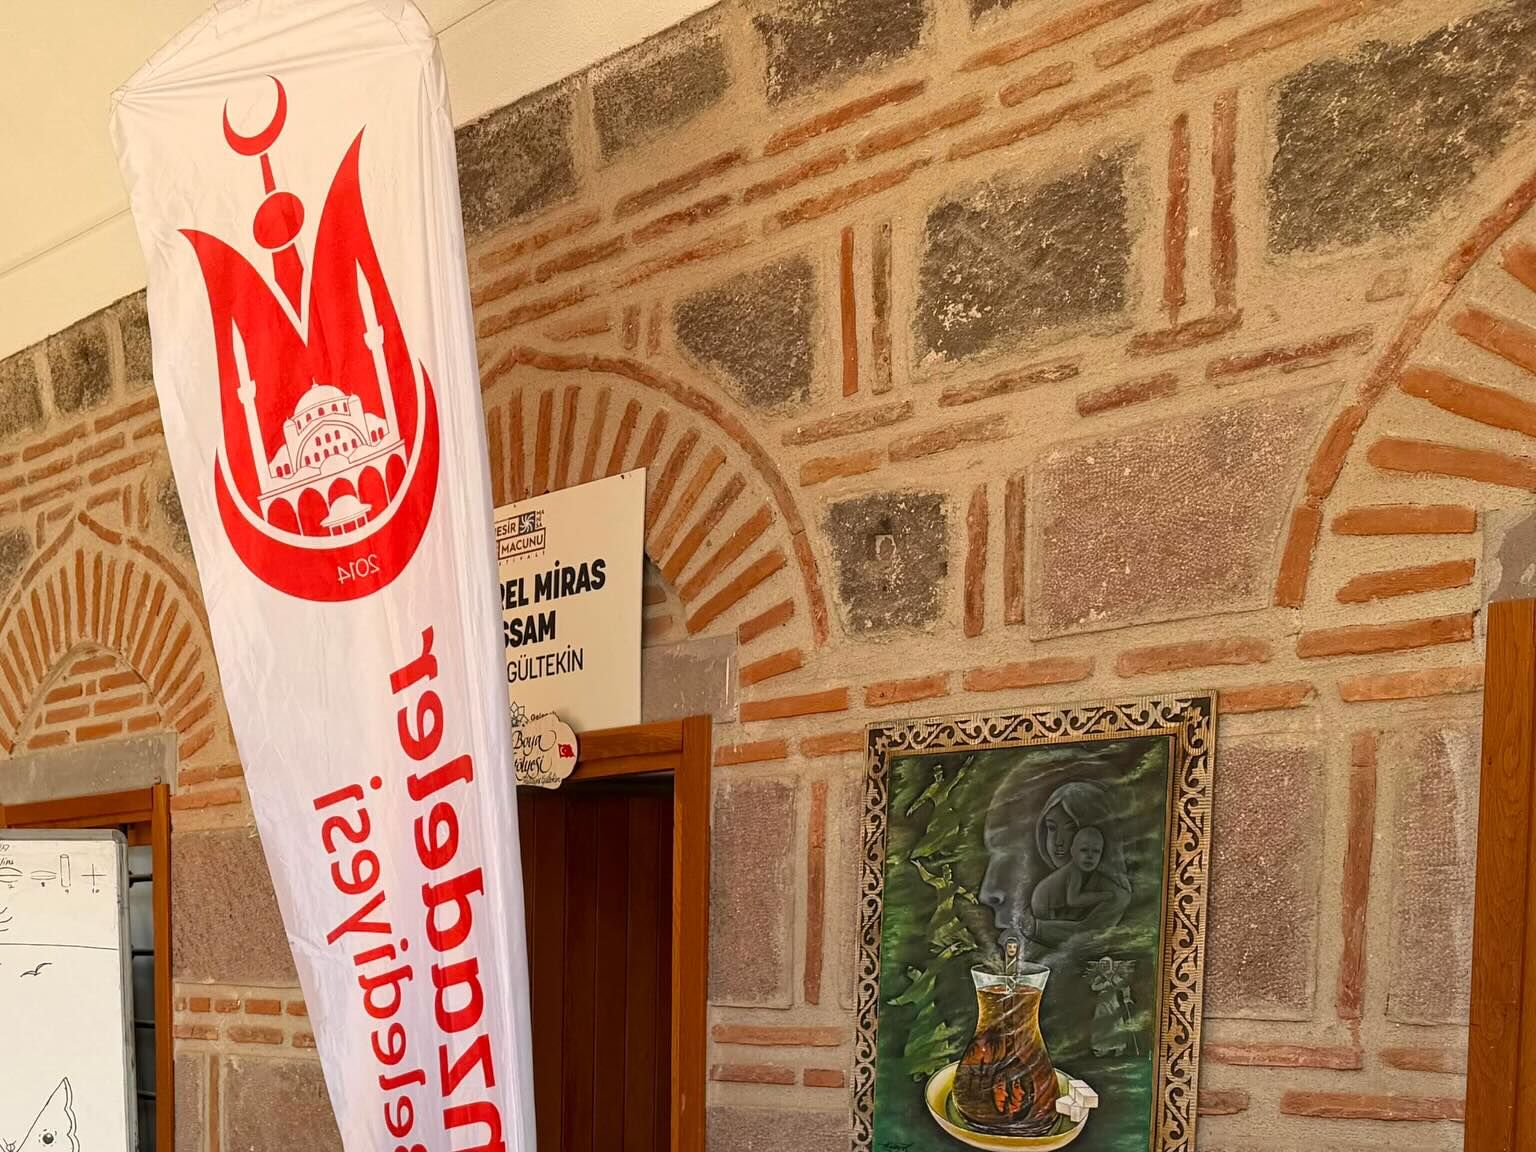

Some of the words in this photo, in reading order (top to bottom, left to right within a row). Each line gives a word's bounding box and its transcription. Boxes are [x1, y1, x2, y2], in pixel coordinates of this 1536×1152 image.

[495, 521, 516, 537] ESİR
[501, 534, 544, 554] MACUNU
[534, 559, 606, 603] MİRAS
[507, 645, 583, 683] GÜLTEKİN
[513, 731, 556, 756] Boya
